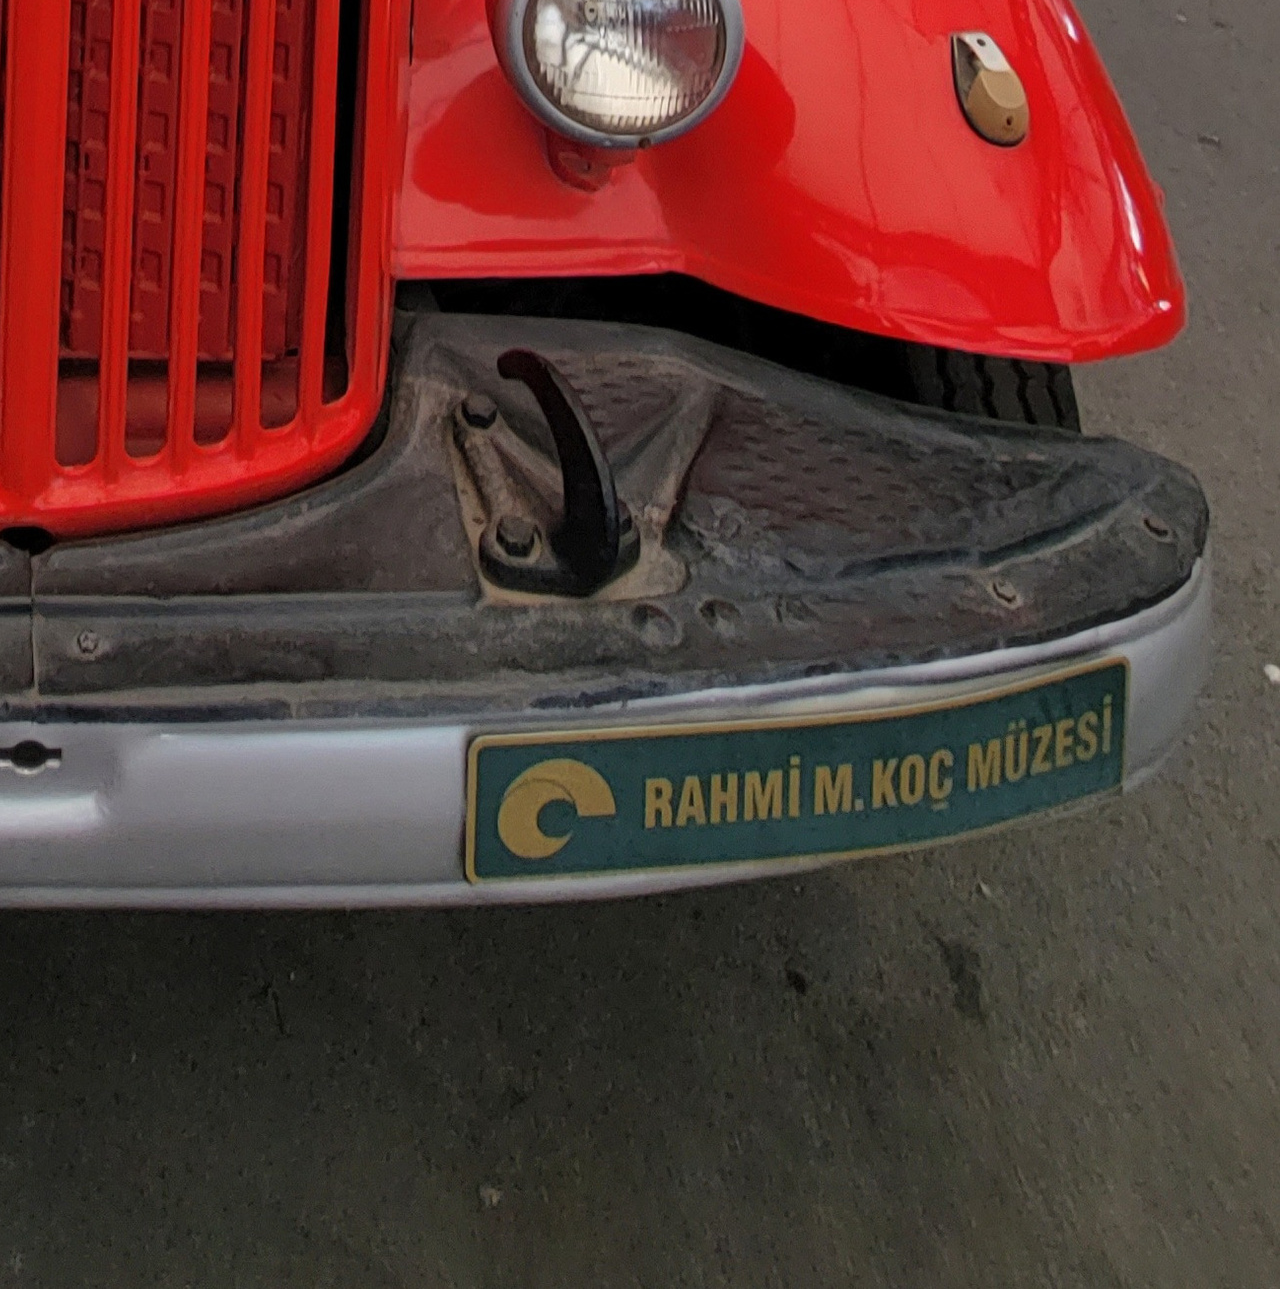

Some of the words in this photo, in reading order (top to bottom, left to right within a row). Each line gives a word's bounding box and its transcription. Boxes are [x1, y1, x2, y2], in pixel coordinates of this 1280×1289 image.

[645, 755, 801, 829] RAHMİ
[814, 763, 865, 816] M.
[871, 748, 955, 811] KOÇ
[966, 693, 1114, 793] MÜZESİ
